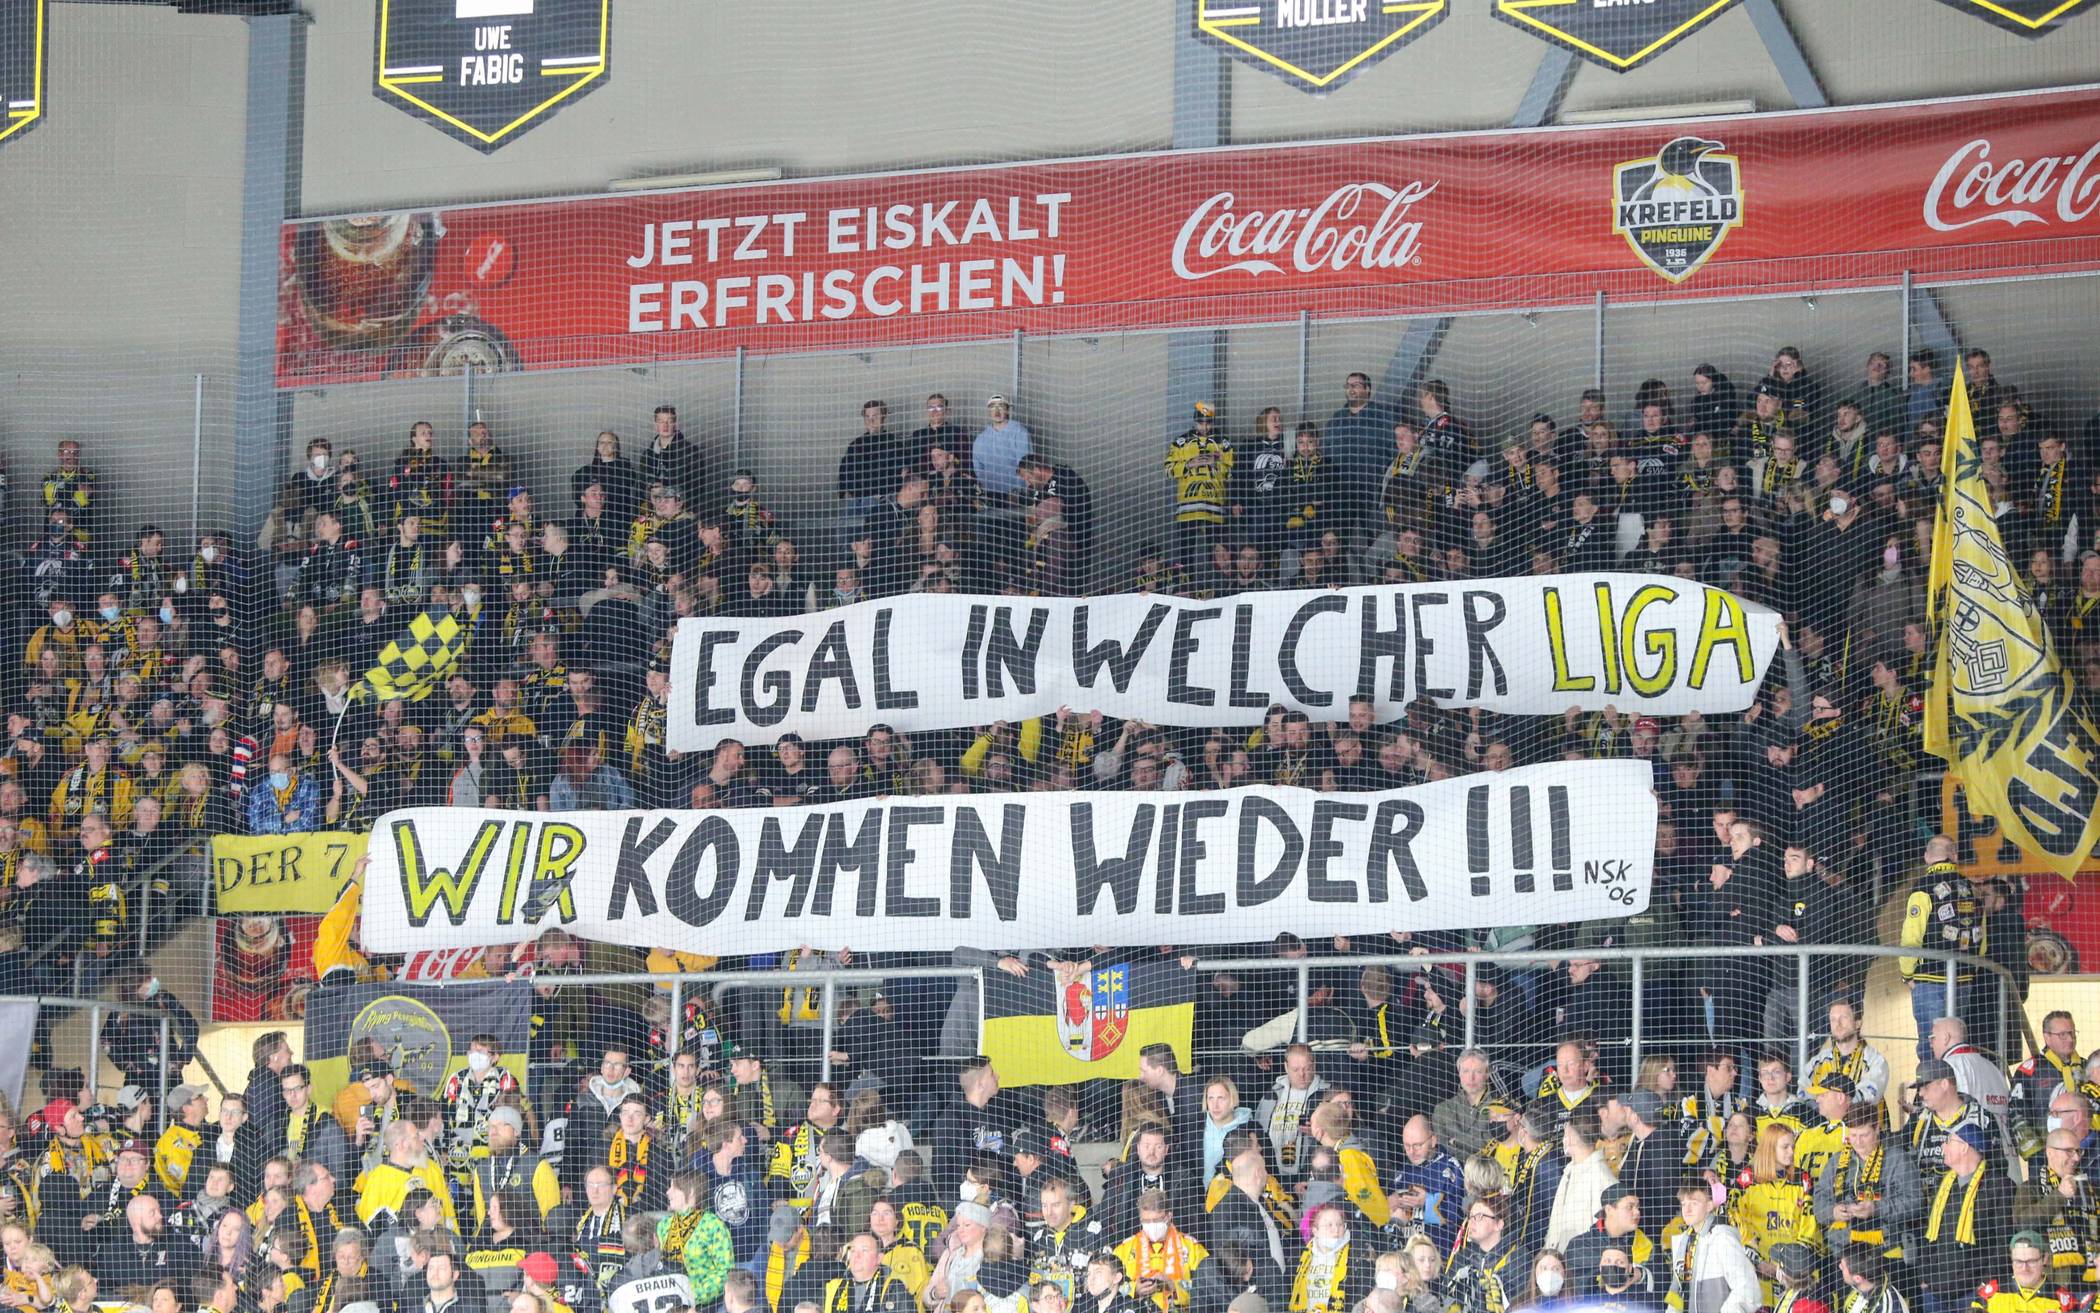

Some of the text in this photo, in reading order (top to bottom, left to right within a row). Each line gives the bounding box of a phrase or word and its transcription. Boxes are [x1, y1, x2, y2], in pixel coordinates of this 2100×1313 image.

[474, 25, 512, 51] UWE
[460, 53, 523, 86] FABIG
[1923, 138, 2100, 232] Coca-C
[1619, 197, 1737, 228] KREFELD
[627, 192, 1072, 268] JETZT EISKALT
[1171, 179, 1441, 280] Coca-Cola
[1640, 226, 1713, 244] PINGUINE
[1665, 248, 1687, 258] 1936
[628, 254, 1067, 333] ERFRISCHEN!
[695, 581, 1756, 728] EGAL IN WELCHER LIGA
[217, 843, 350, 896] DER 7
[391, 784, 1574, 928] WIR KOMMEN WIEDER !!!
[1584, 859, 1633, 885] NSK
[1605, 886, 1638, 906] '06
[2049, 1236, 2079, 1253] 2003
[564, 1285, 583, 1304] 24
[635, 1277, 676, 1294] BRAUN
